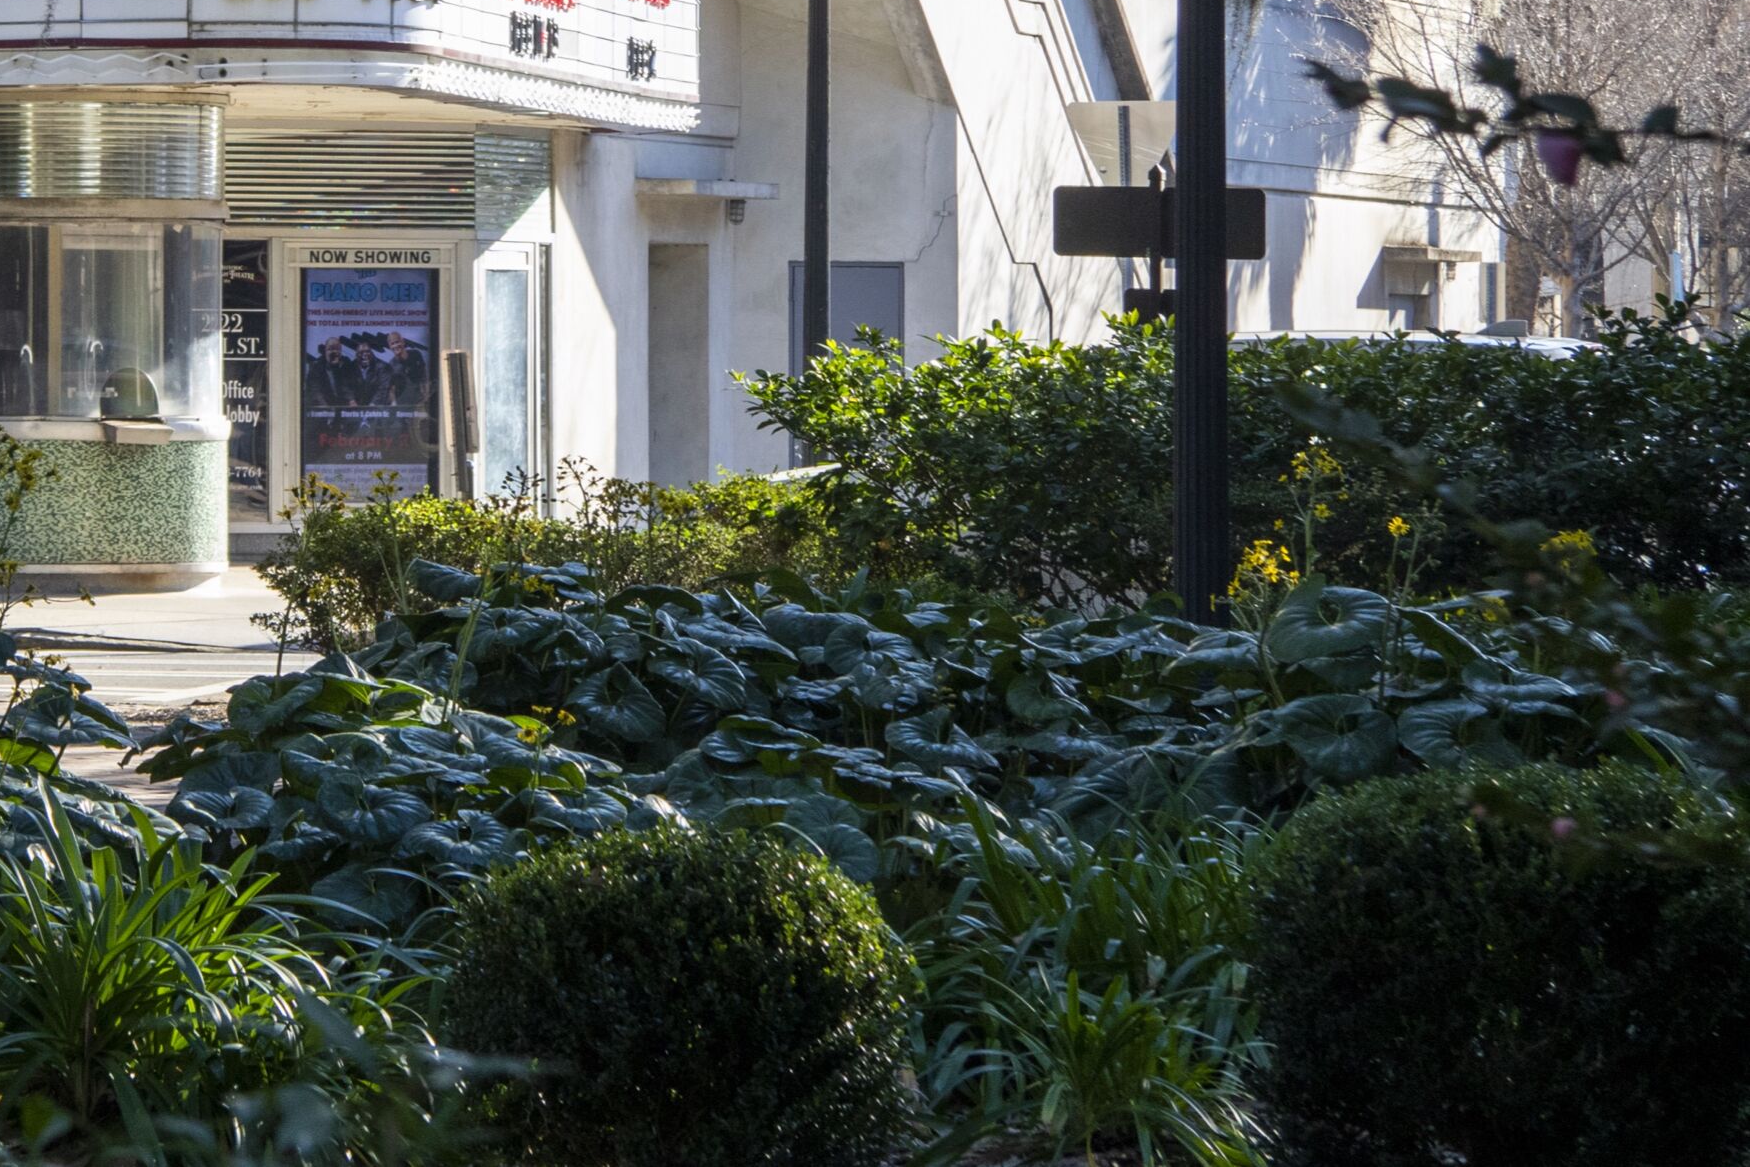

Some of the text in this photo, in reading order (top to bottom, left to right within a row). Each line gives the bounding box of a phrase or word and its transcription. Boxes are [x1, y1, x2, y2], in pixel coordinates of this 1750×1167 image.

[309, 249, 432, 264] NOW SHOWING
[310, 281, 426, 302] PIANO MEN
[237, 337, 264, 355] ST.
[222, 380, 254, 399] Office
[345, 452, 355, 460] at
[366, 451, 383, 460] PM
[229, 466, 262, 478] -7764
